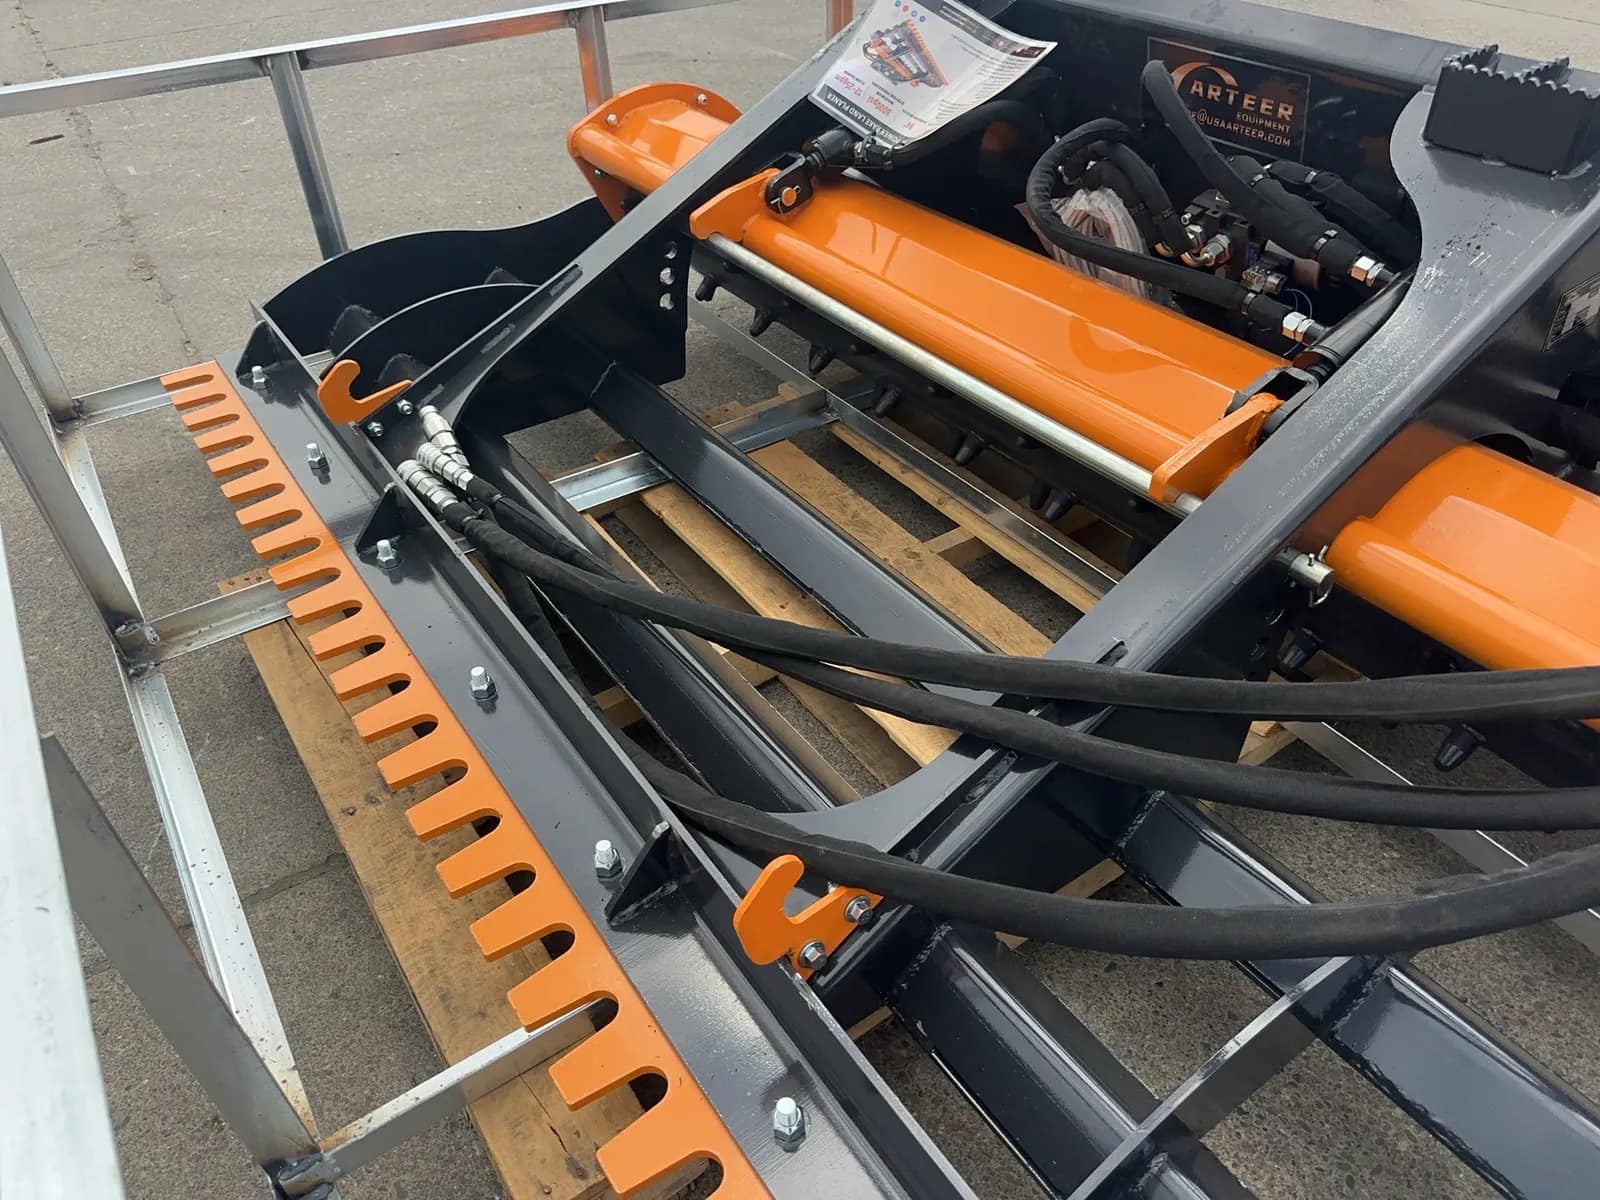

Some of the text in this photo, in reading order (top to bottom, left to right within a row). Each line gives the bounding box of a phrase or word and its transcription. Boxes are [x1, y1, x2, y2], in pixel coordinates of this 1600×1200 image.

[825, 91, 900, 144] POWER RAKE LAND PLANER
[1190, 80, 1294, 121] ARTEER
[1190, 108, 1291, 148] E@USAARTEER.COM
[1236, 111, 1291, 133] EQUIPMENT
